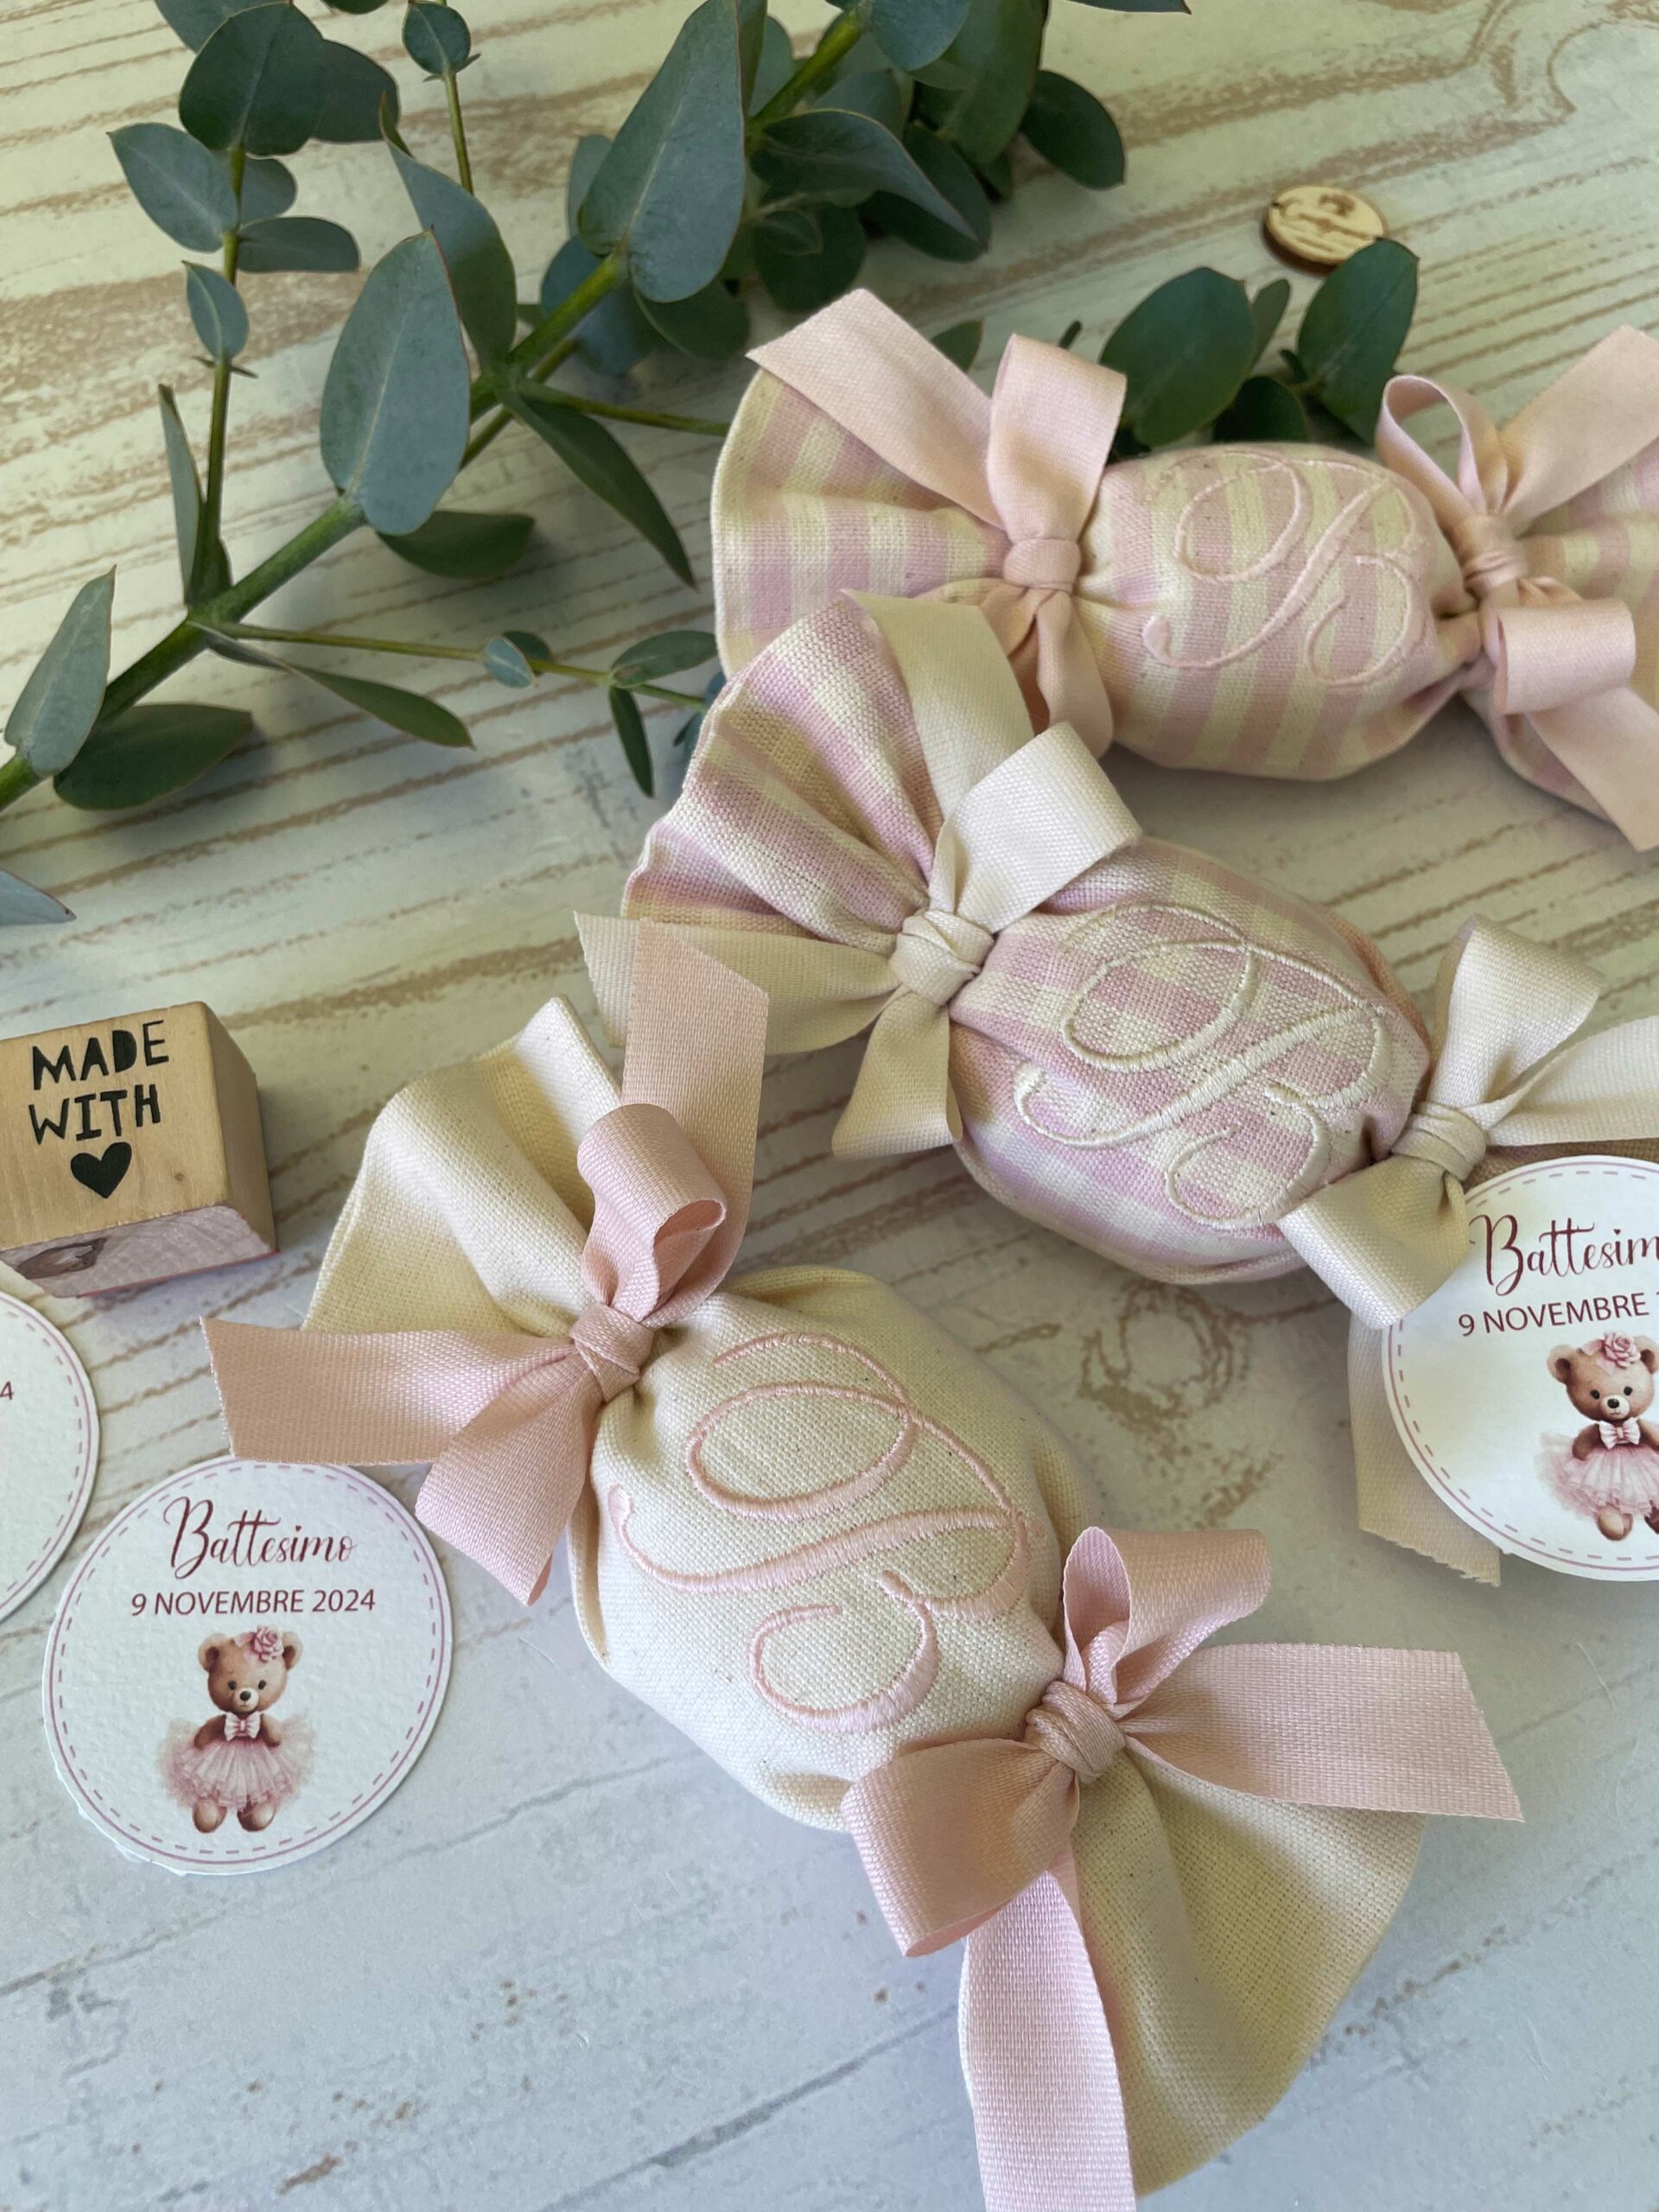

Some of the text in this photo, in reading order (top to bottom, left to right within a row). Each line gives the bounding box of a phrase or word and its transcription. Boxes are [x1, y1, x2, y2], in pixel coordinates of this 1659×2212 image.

[32, 1020, 169, 1090] MADE
[29, 1084, 162, 1145] WITH
[1469, 1214, 1659, 1296] Battesim
[1458, 1293, 1649, 1337] 9 NOVEMBRE
[163, 1496, 357, 1580] Battesimo
[131, 1588, 376, 1616] 9 NOVEMBRE 2024
